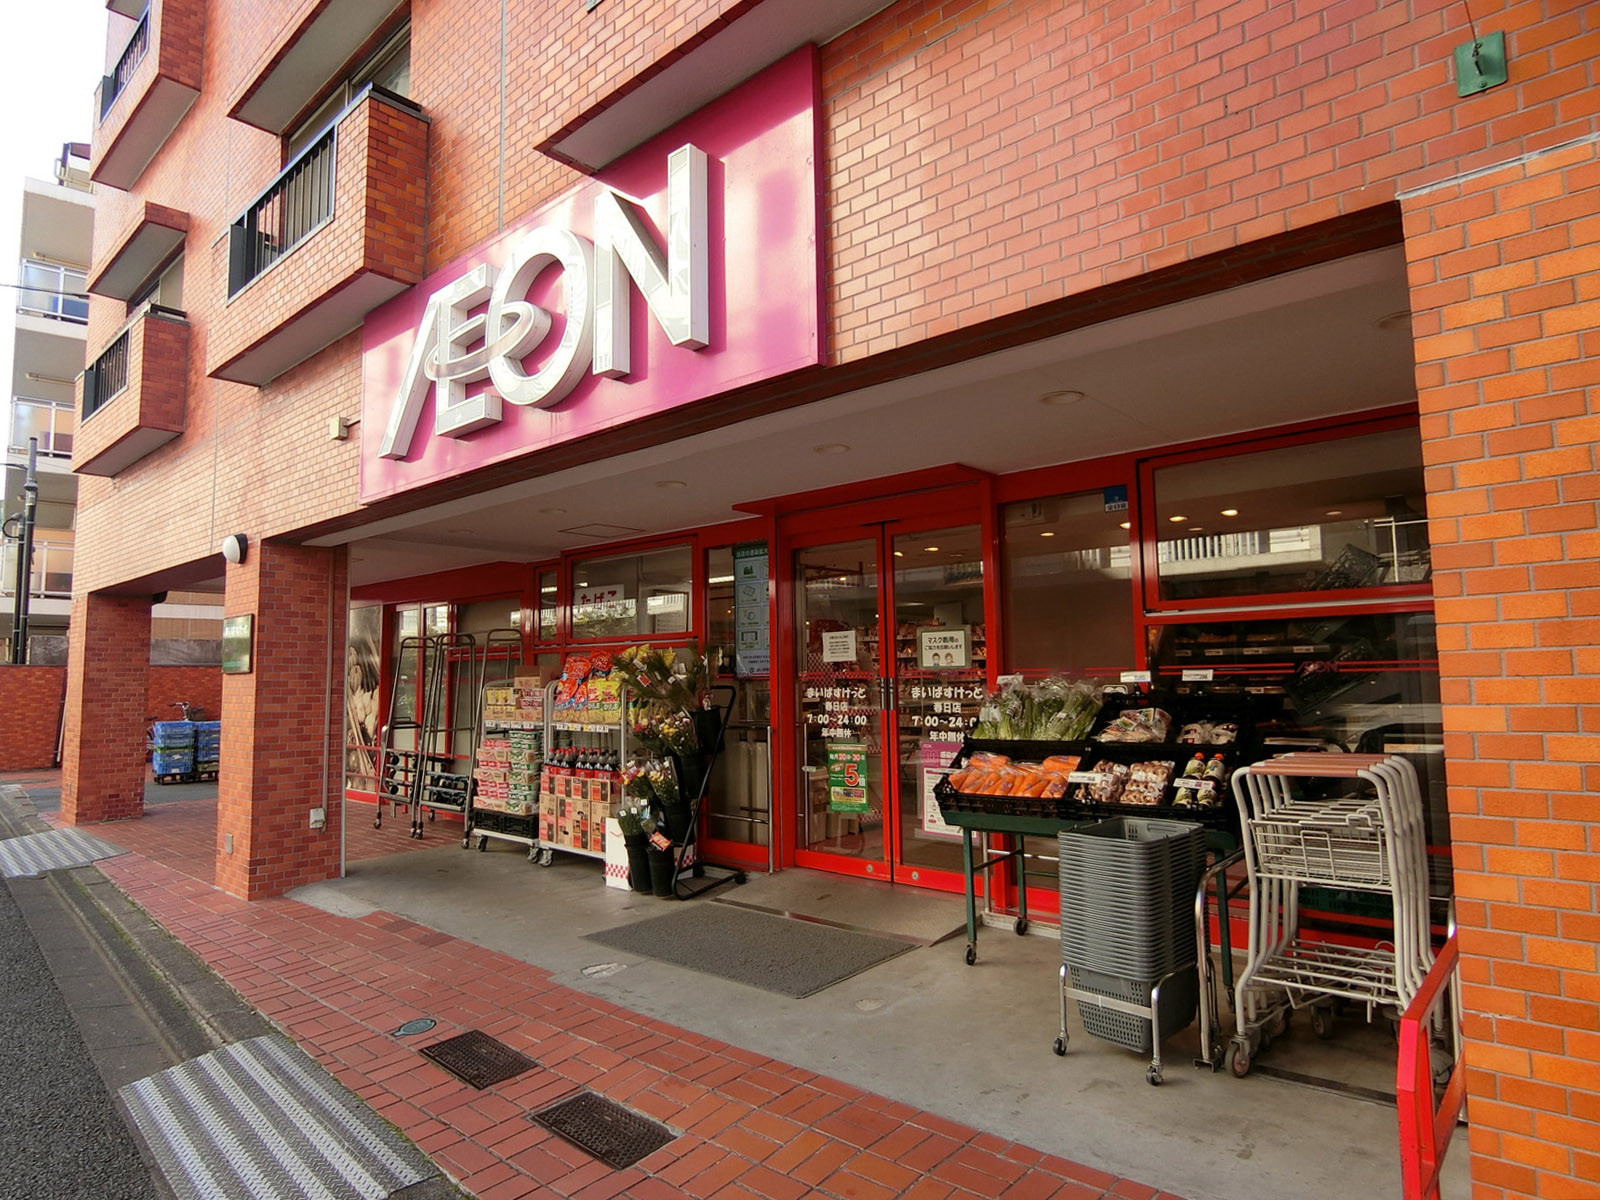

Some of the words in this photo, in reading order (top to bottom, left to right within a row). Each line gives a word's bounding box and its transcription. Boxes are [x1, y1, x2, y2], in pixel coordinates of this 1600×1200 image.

[806, 687, 867, 699] まいばすけっと
[911, 686, 984, 699] まいばすけっと
[825, 701, 848, 711] 春日店
[933, 702, 962, 713] 春日店
